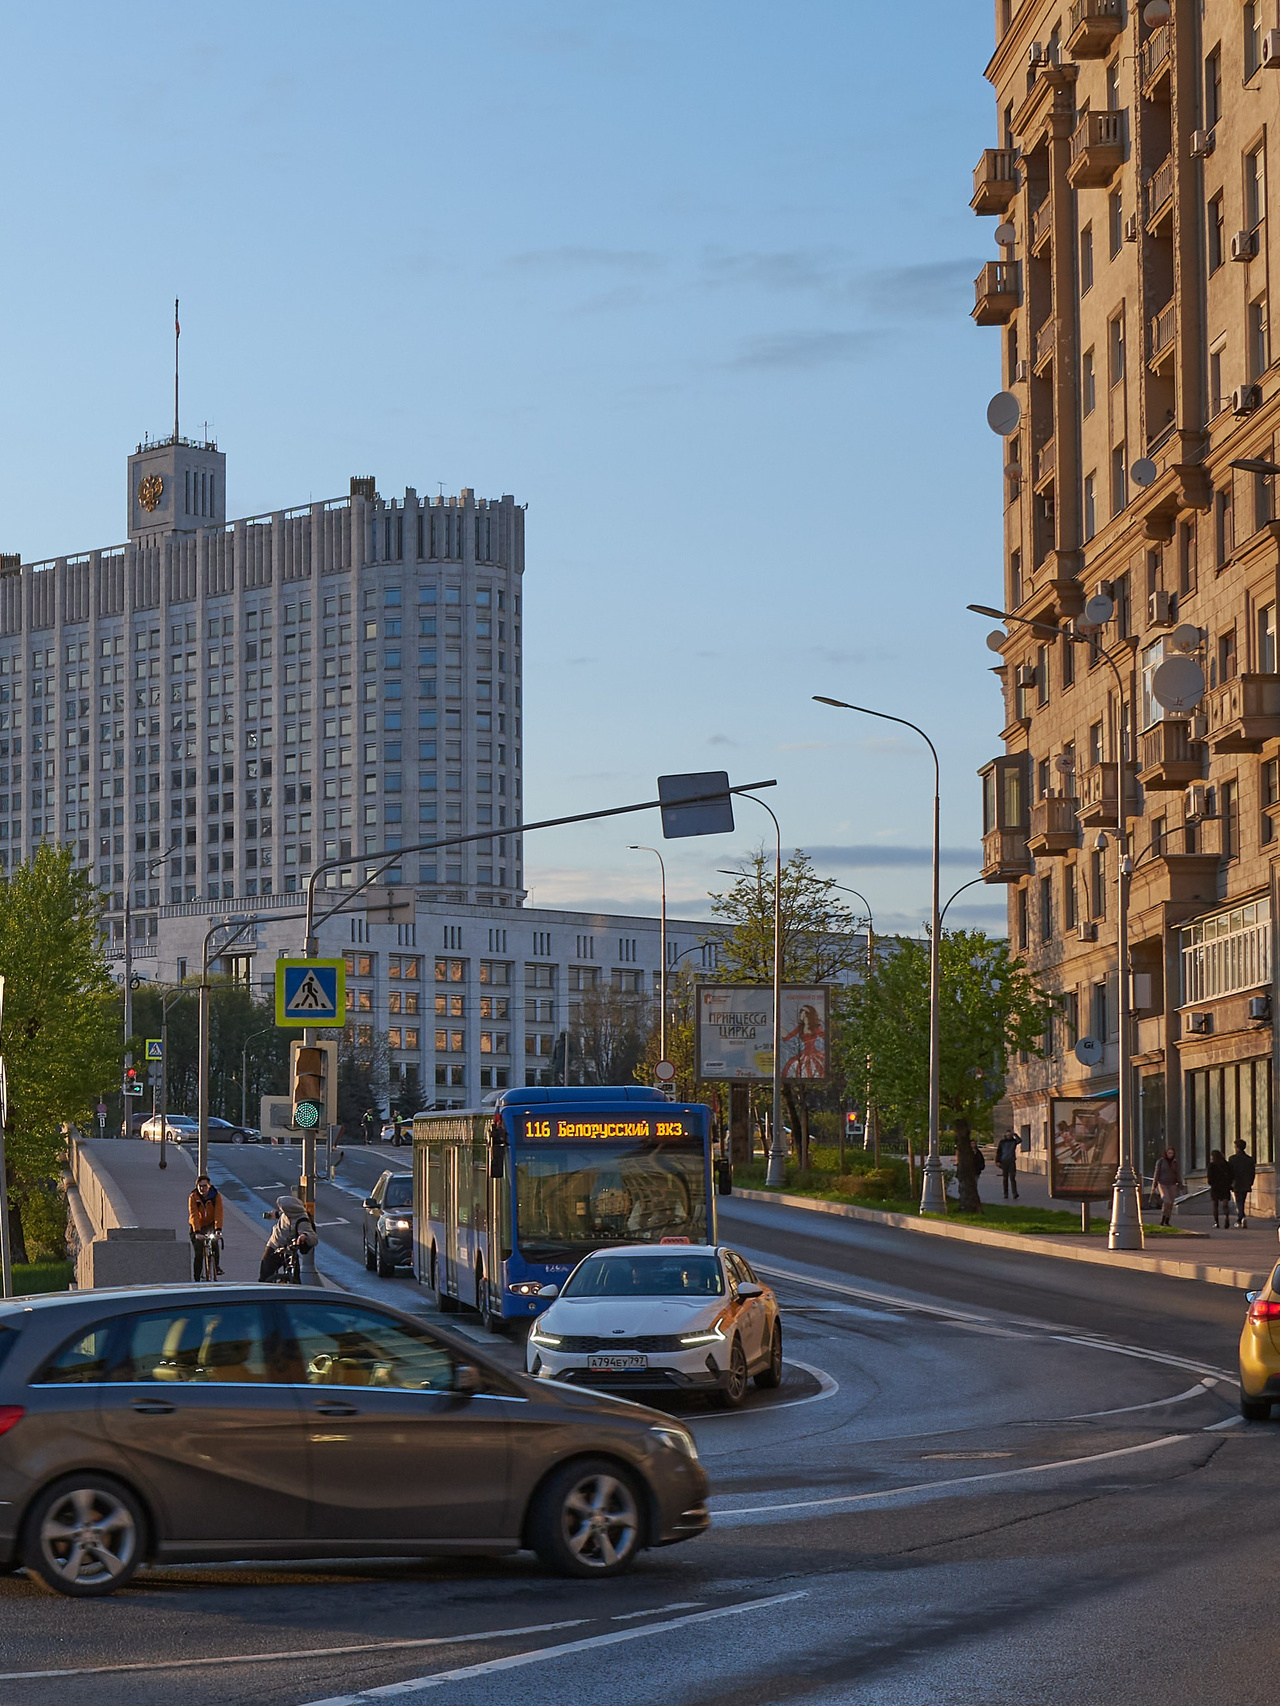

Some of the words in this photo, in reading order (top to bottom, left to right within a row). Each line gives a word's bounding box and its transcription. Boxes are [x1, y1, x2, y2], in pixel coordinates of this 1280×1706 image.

[708, 1012, 767, 1026] ПРИНЦЕССА
[719, 1026, 756, 1039] ЦИРКА
[525, 1121, 551, 1138] 116
[557, 1120, 650, 1139] Белорусский
